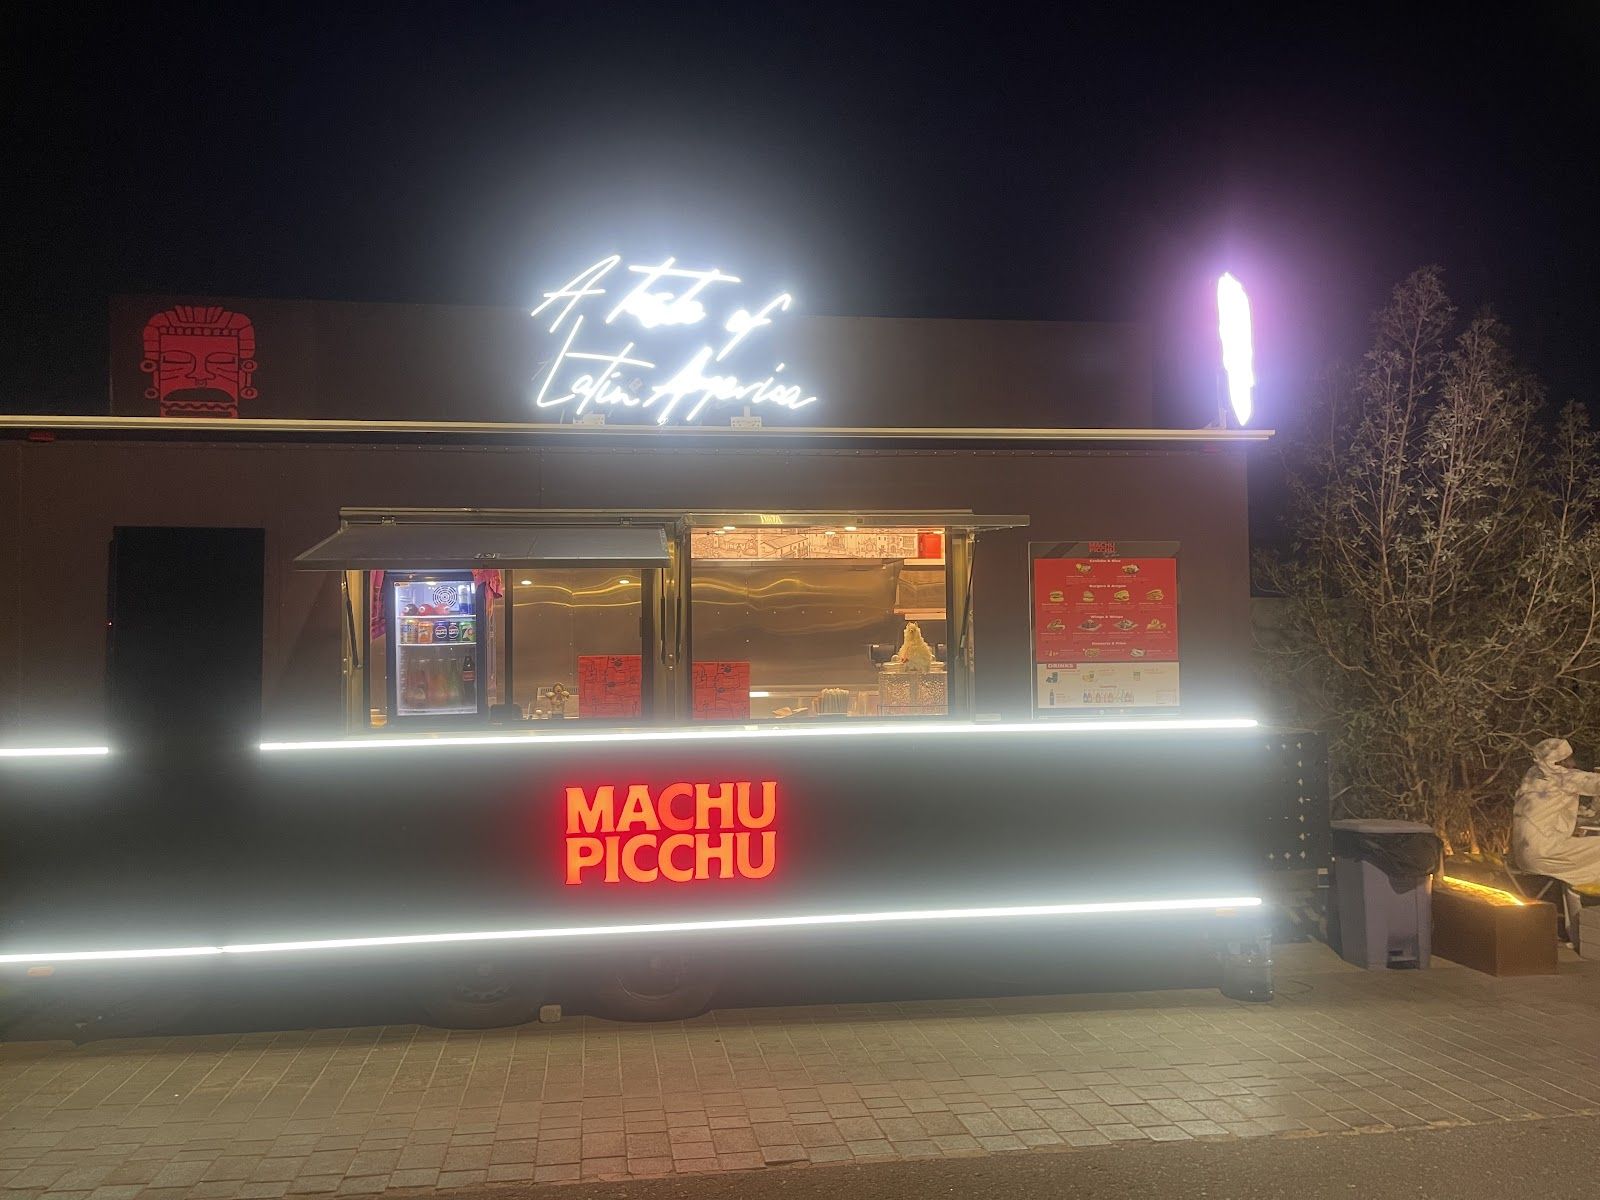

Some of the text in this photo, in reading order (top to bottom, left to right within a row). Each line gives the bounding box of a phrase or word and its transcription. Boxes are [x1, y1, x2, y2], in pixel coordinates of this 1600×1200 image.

[531, 254, 621, 334] A
[716, 293, 792, 362] of
[537, 315, 656, 416] Latin
[565, 781, 777, 834] MACHU
[565, 831, 777, 885] PICCHU
